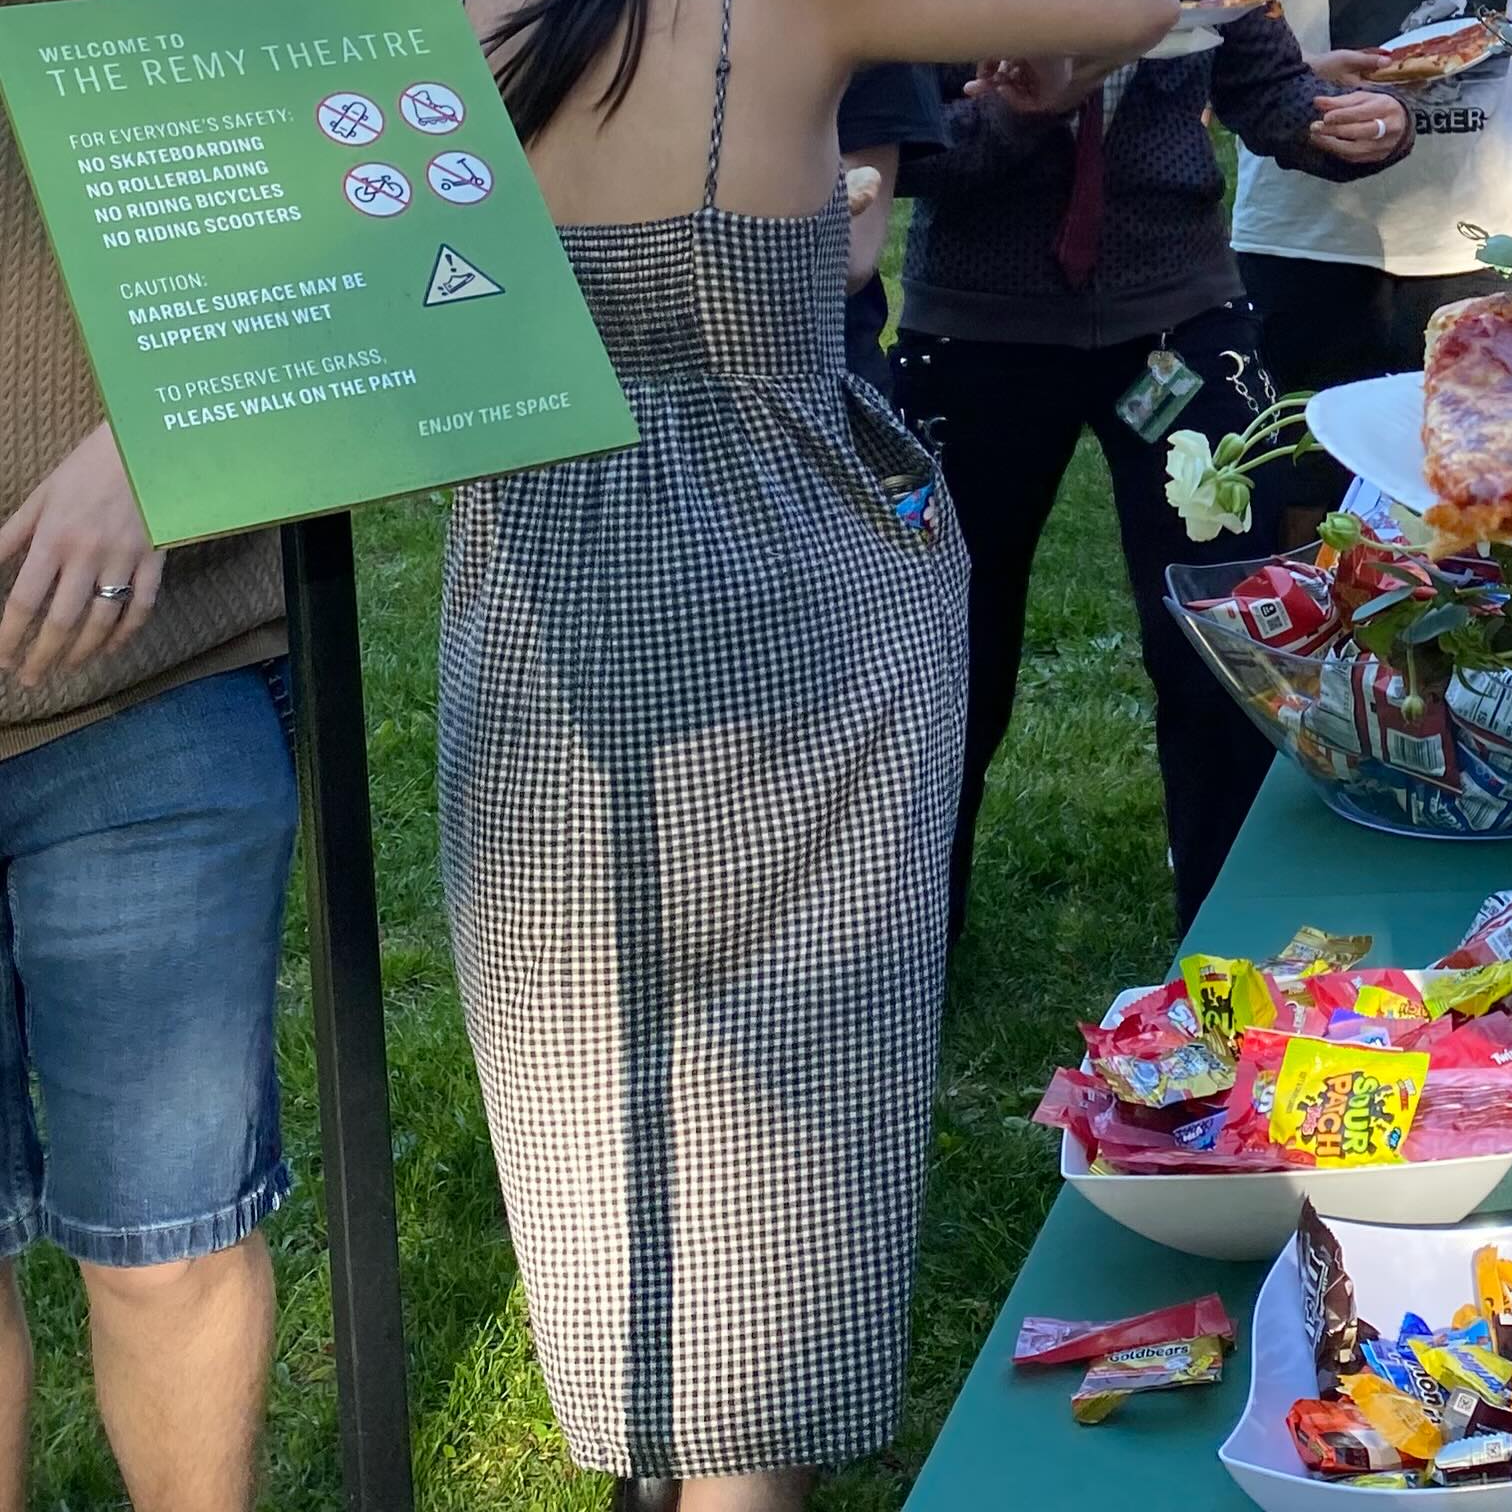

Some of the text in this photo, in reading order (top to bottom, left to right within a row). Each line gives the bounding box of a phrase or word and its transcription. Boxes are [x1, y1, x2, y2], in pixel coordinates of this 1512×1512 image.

[38, 33, 185, 64] WELCOME TO
[45, 28, 431, 97] THE REMY THEATRE
[68, 107, 294, 150] FOR EVERYONE'S SAFETY:
[77, 135, 265, 174] NO SKATEBOARDING
[85, 159, 270, 199] NO ROLLERBLADING
[93, 183, 285, 224] NO RIDING BICYCLES
[102, 205, 302, 249] NO RIDING SCOOTERS
[119, 272, 208, 300] CAUTION:
[127, 272, 368, 326] MARBLE SURFACE MAY BE
[136, 303, 332, 352] SLIPPERY WHEN WET
[154, 348, 388, 404] TO PRESERVE THE GRASS,
[163, 368, 417, 431] PLEASE WALK ON THE PATH
[418, 391, 571, 436] ENJOY THE SPACE
[1313, 1071, 1354, 1158] PATCH
[1341, 1075, 1376, 1155] SOUR
[1108, 1343, 1190, 1363] Goldbears
